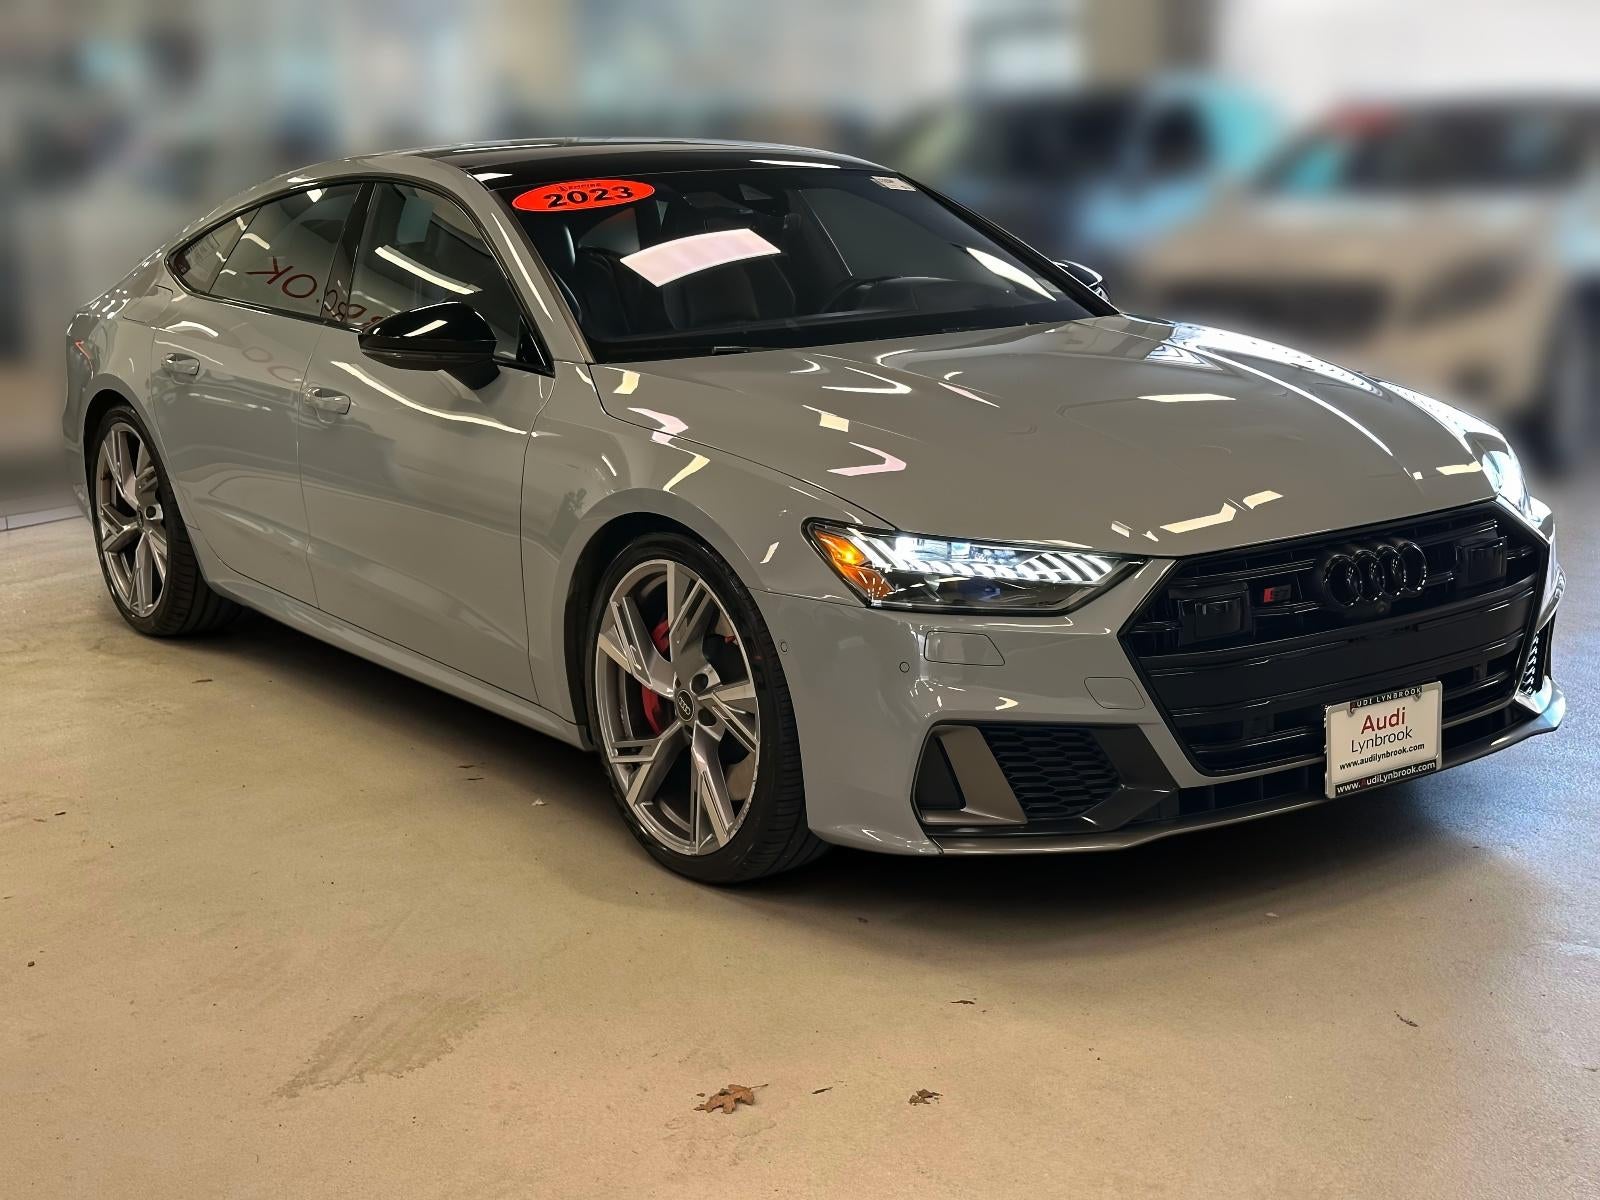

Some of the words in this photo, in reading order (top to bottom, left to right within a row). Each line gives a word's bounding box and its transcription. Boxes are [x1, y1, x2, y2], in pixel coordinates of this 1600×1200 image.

[543, 186, 634, 208] 2023
[1376, 687, 1422, 703] LYNBROOK
[1360, 706, 1406, 735] Audi
[1351, 726, 1413, 754] Lynbrook
[1339, 743, 1425, 770] www.audilynbrook.com
